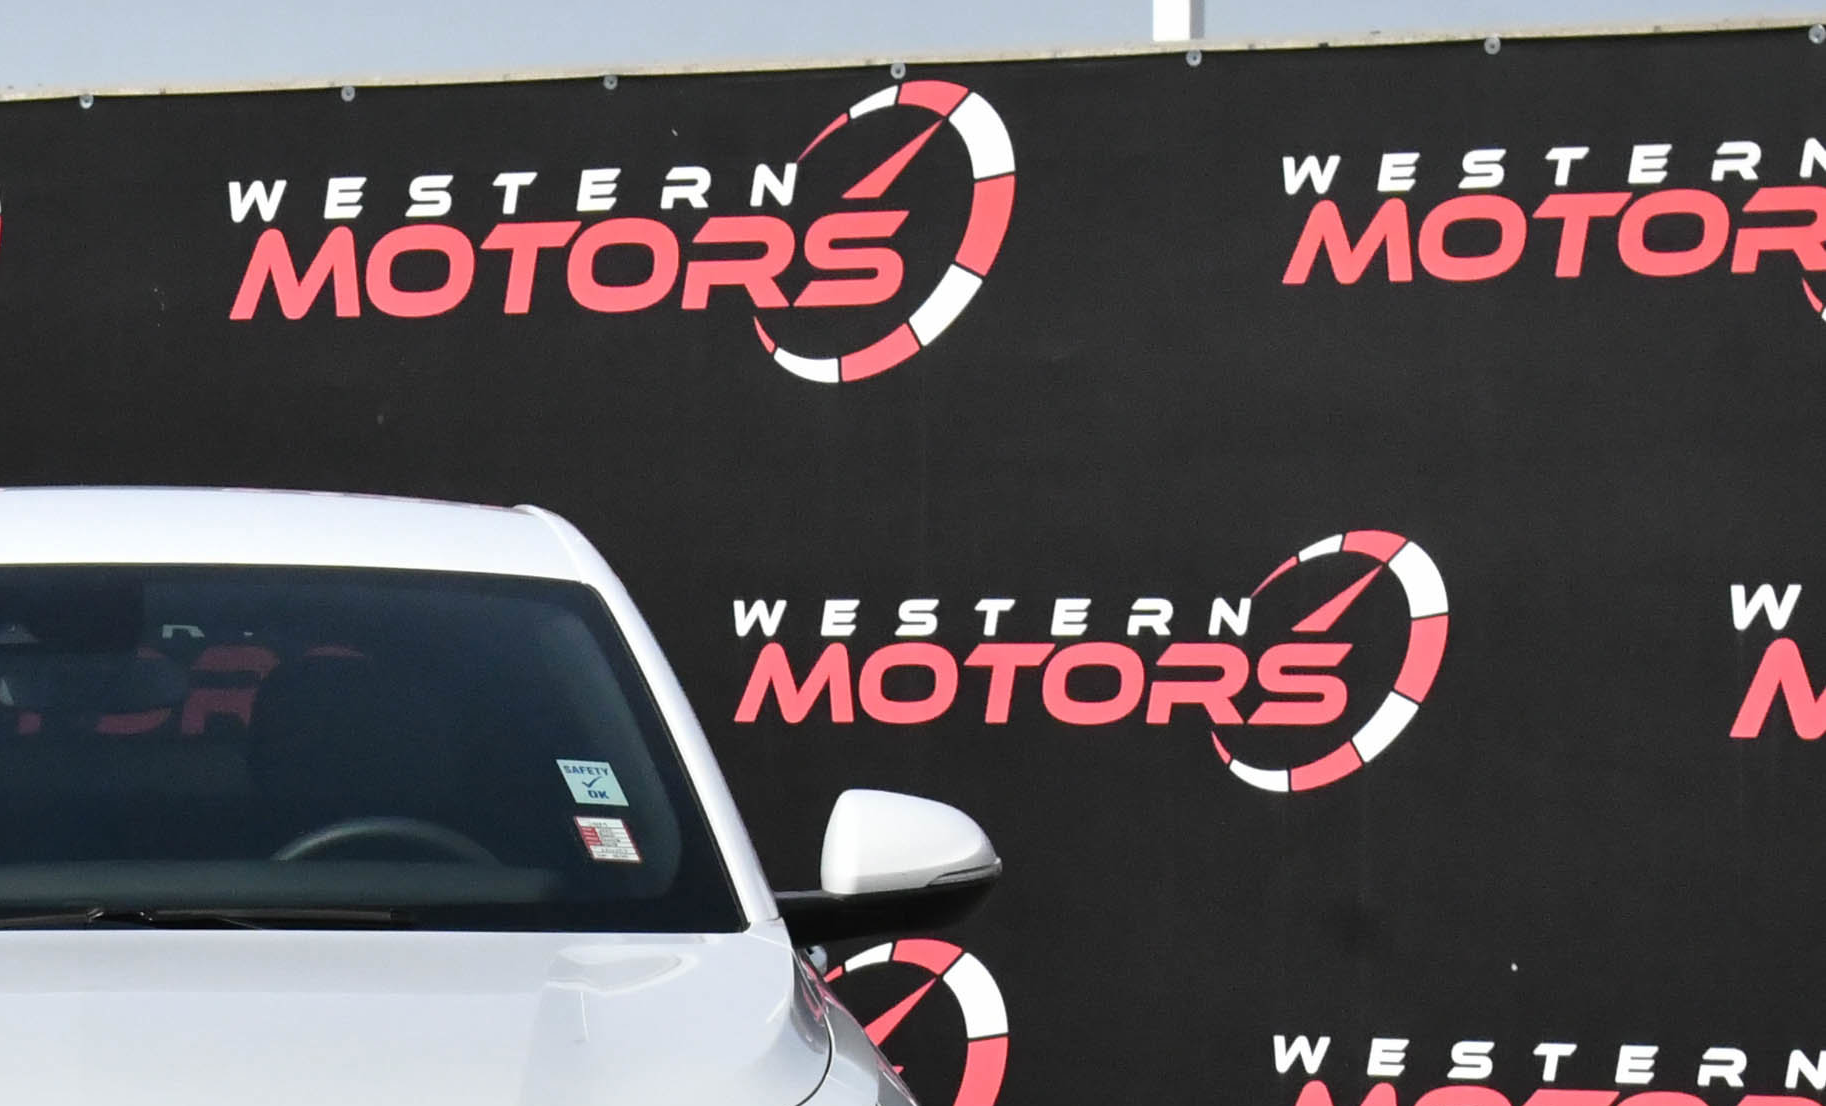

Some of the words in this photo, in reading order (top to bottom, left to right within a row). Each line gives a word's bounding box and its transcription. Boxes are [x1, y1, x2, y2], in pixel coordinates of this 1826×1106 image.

[228, 162, 798, 223] WESTERN
[229, 209, 911, 321] MOTORS
[733, 597, 1252, 637] WESTERN
[1729, 583, 1803, 631] W
[733, 641, 1354, 726] MOTORS
[563, 765, 609, 776] SAFETY
[587, 789, 610, 799] OK
[1273, 1035, 1826, 1090] WESTERN
